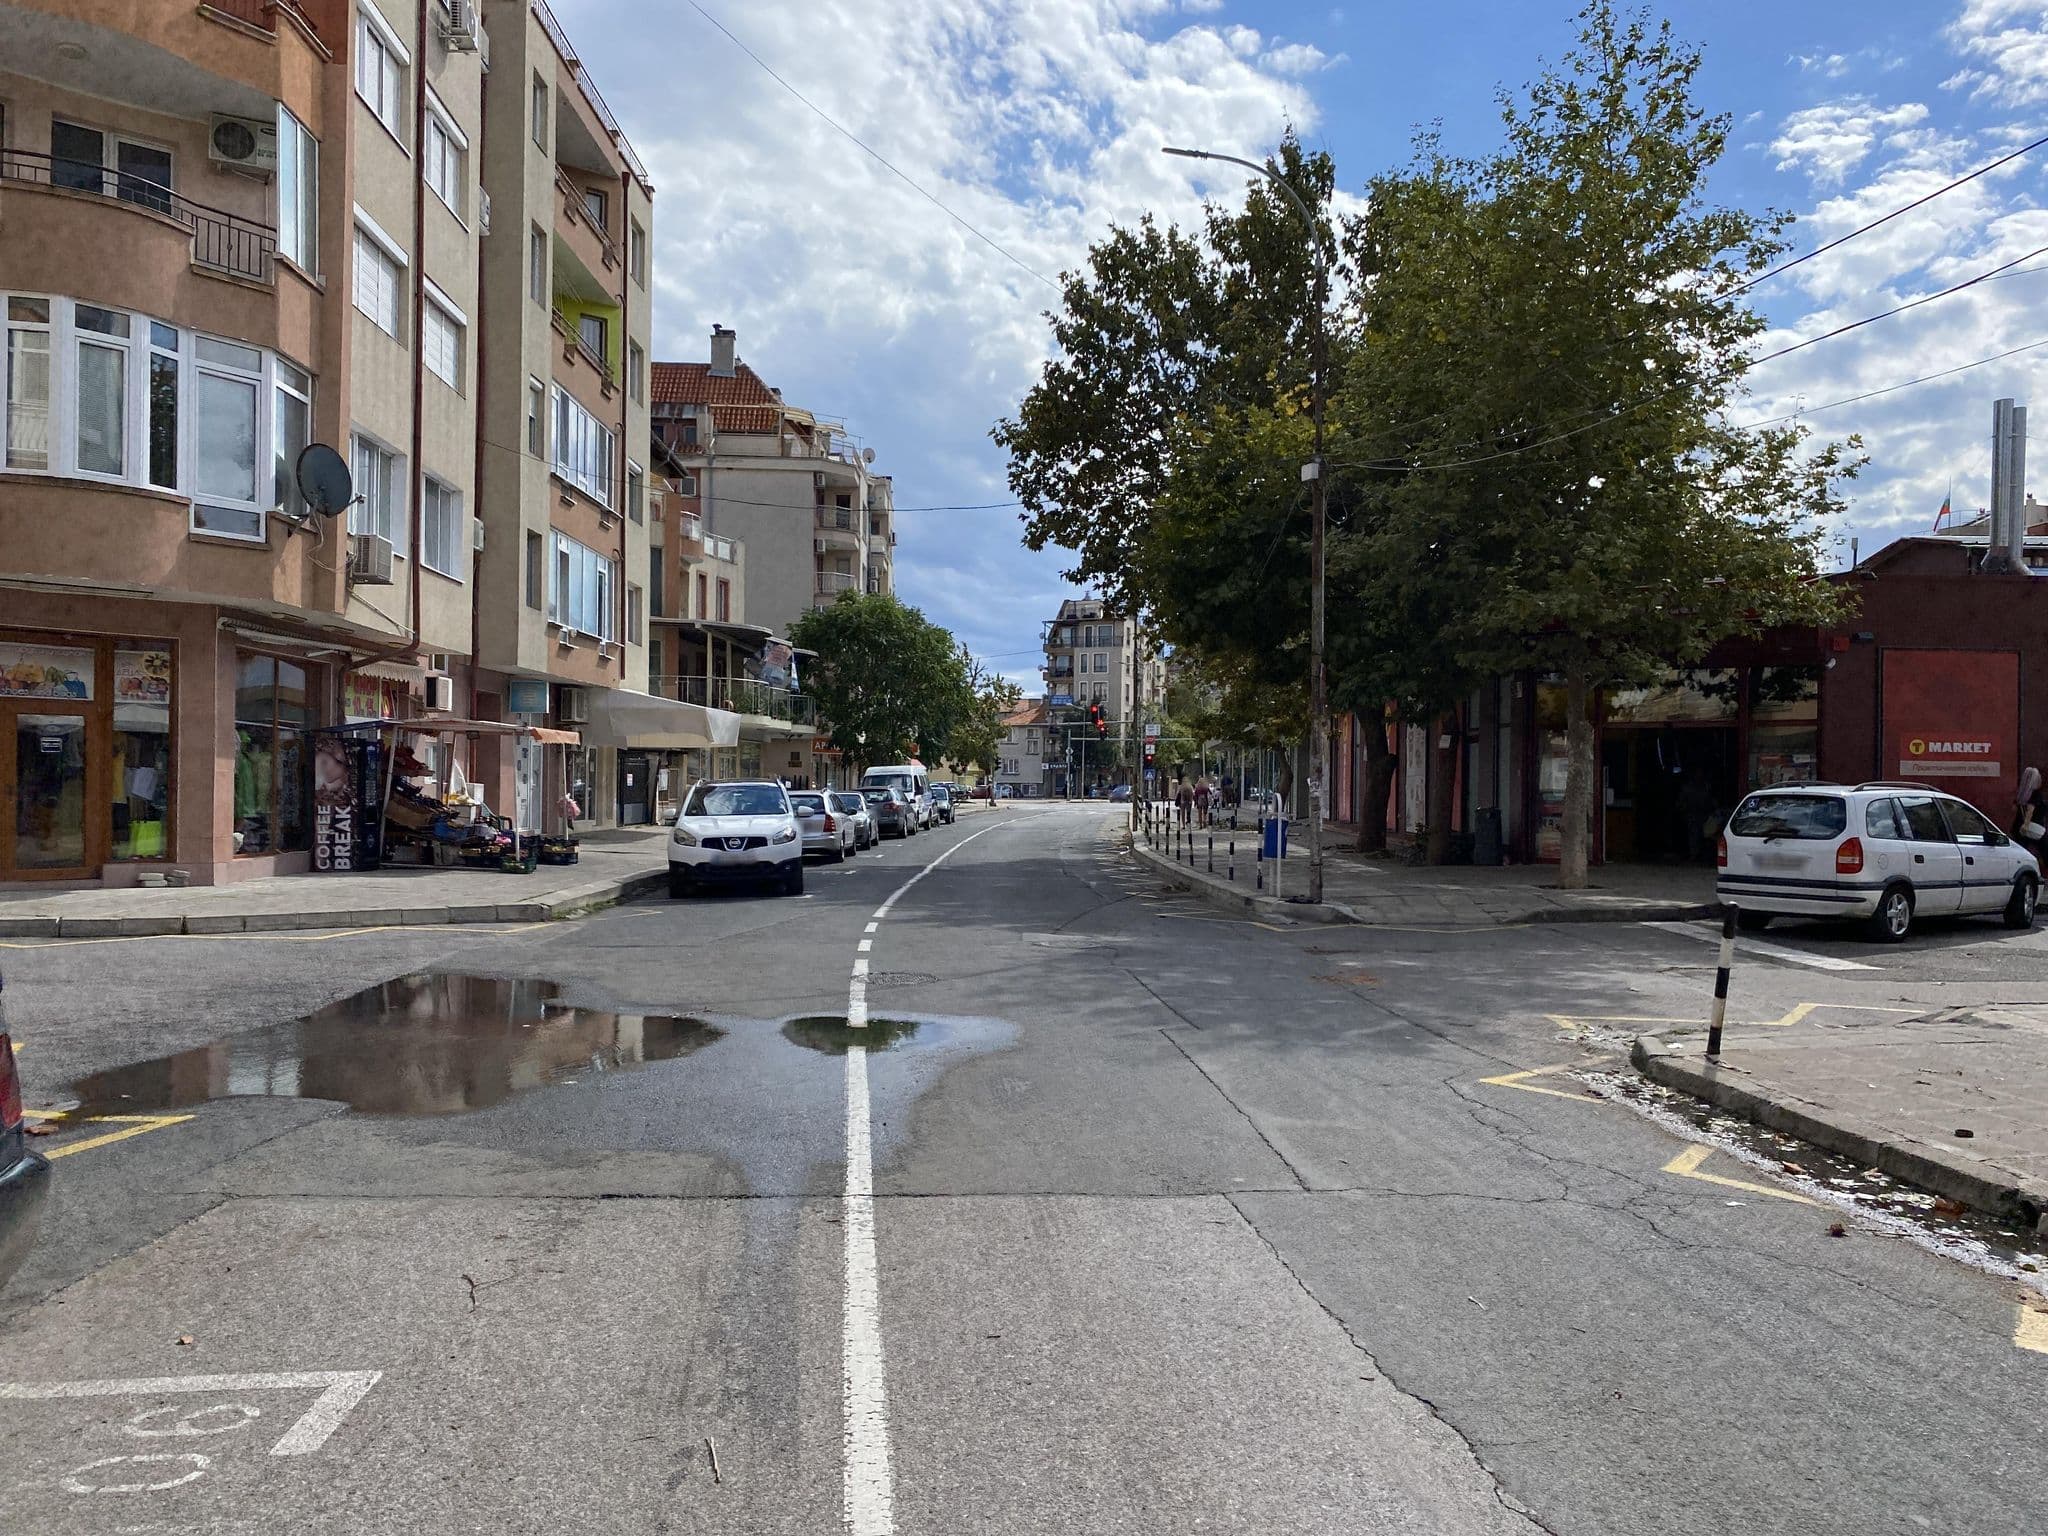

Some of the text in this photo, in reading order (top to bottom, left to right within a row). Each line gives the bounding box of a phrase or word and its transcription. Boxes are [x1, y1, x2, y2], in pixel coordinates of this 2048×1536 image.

[1928, 742, 1991, 753] MARKET
[316, 805, 331, 870] COFFEE
[334, 805, 352, 870] BREAK
